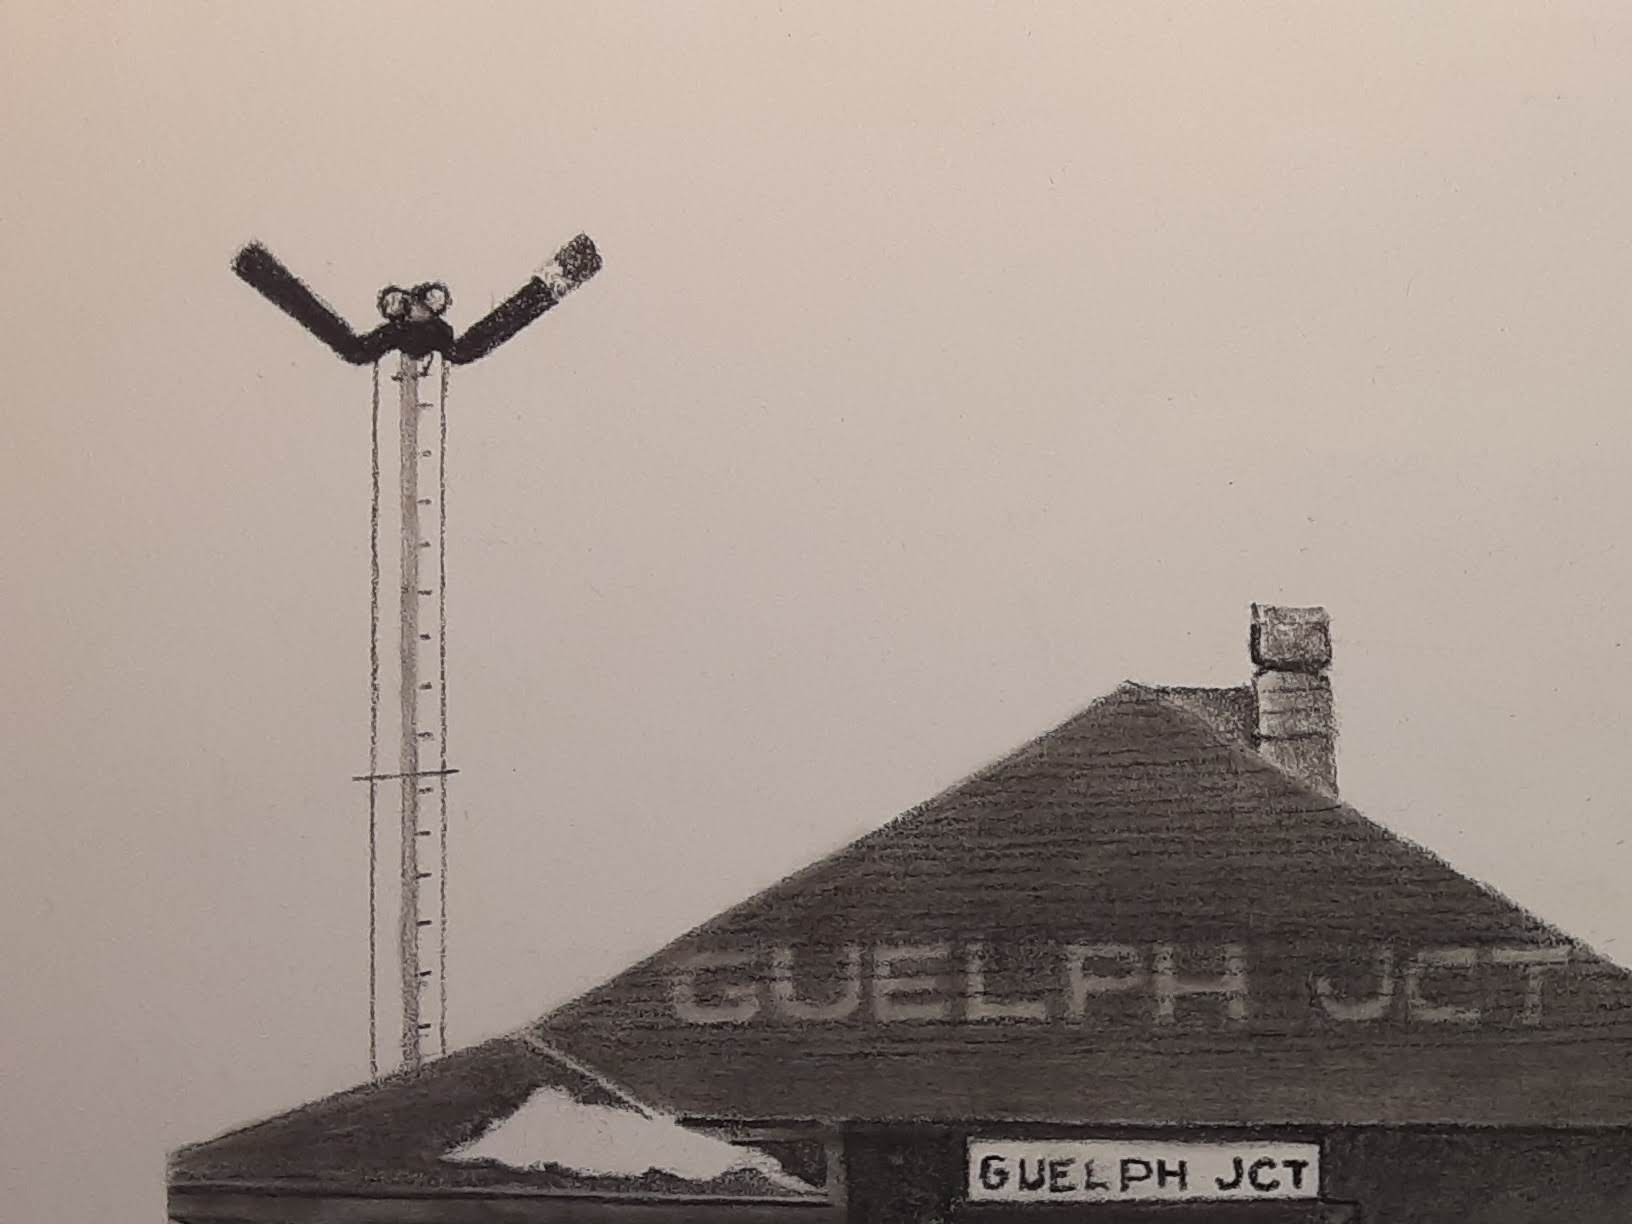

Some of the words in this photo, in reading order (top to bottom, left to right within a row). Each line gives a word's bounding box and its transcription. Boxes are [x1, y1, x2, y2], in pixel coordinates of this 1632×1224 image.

[674, 944, 1247, 1023] GUELPH
[1312, 946, 1568, 1024] JCT
[979, 1154, 1187, 1193] GUELPH
[1215, 1155, 1309, 1193] JCT
